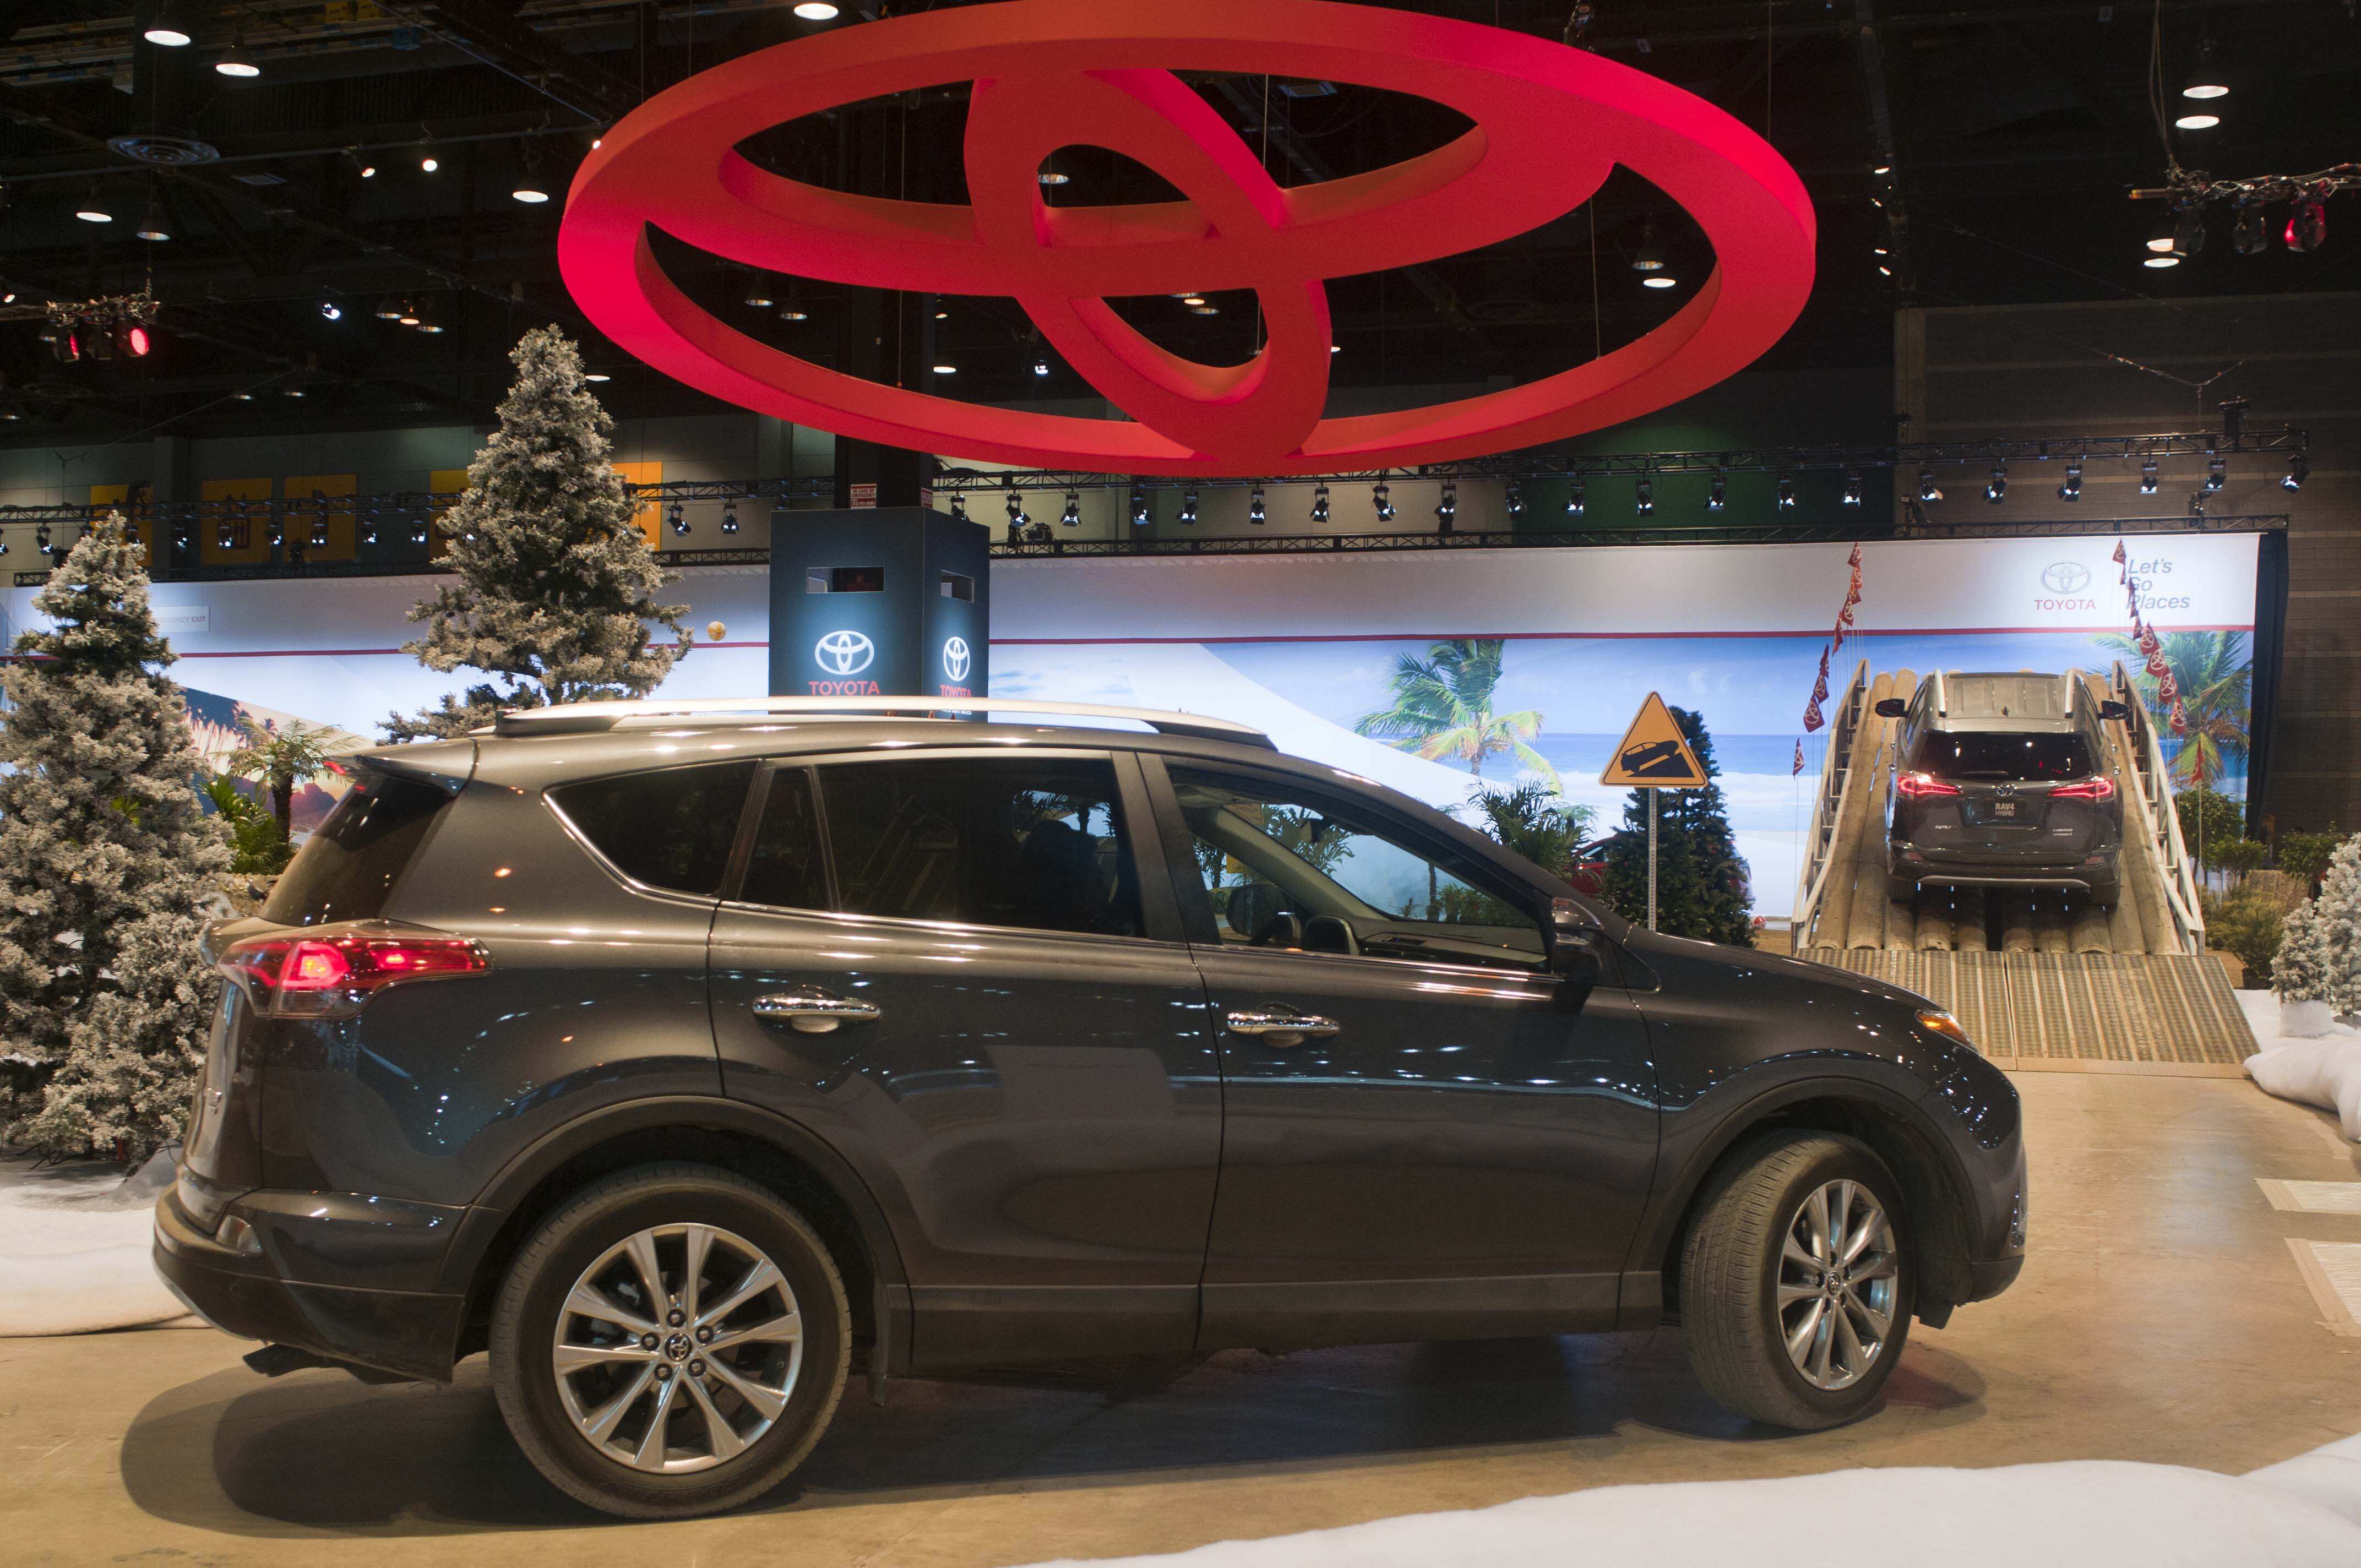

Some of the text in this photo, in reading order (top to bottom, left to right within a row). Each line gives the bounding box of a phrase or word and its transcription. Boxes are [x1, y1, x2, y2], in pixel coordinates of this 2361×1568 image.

[2128, 558, 2172, 573] Let's
[2125, 576, 2152, 591] Go
[2034, 599, 2096, 610] TOYOTA
[2126, 594, 2191, 609] Places
[808, 680, 880, 696] TOYOTA
[940, 684, 972, 698] TOYOTA
